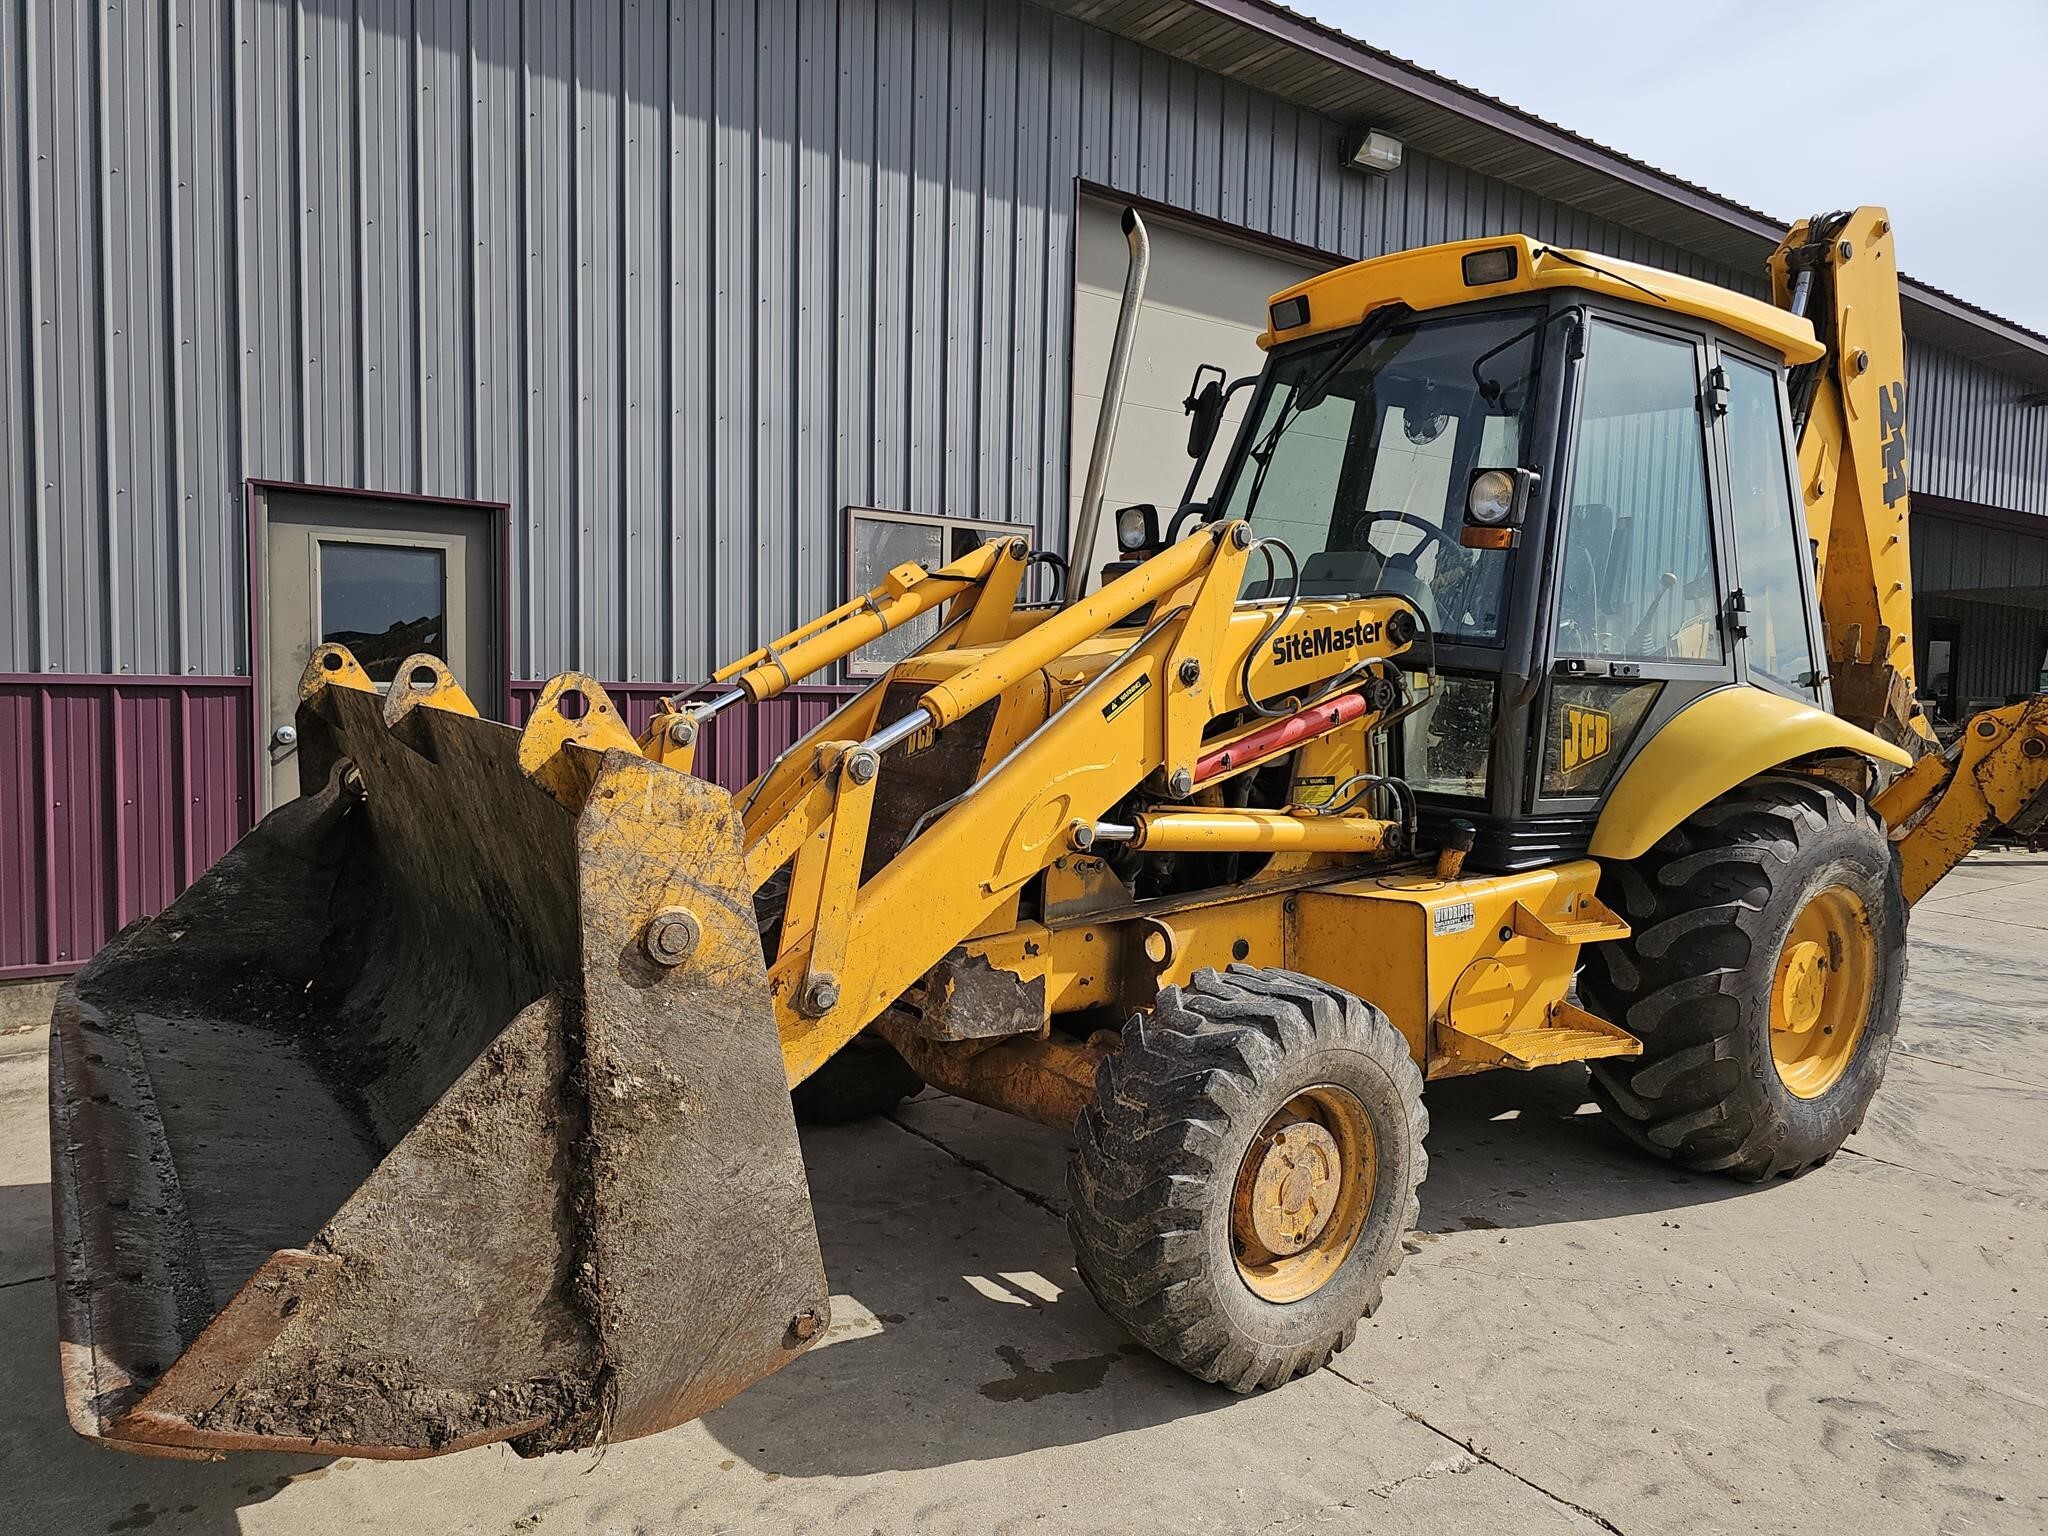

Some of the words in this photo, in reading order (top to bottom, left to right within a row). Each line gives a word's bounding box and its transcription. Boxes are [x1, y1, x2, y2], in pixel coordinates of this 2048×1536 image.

[1879, 381, 1905, 510] 214
[1273, 621, 1382, 666] SiteMaster
[1564, 710, 1607, 769] JCB
[1434, 903, 1473, 923] WINDRIDGE
